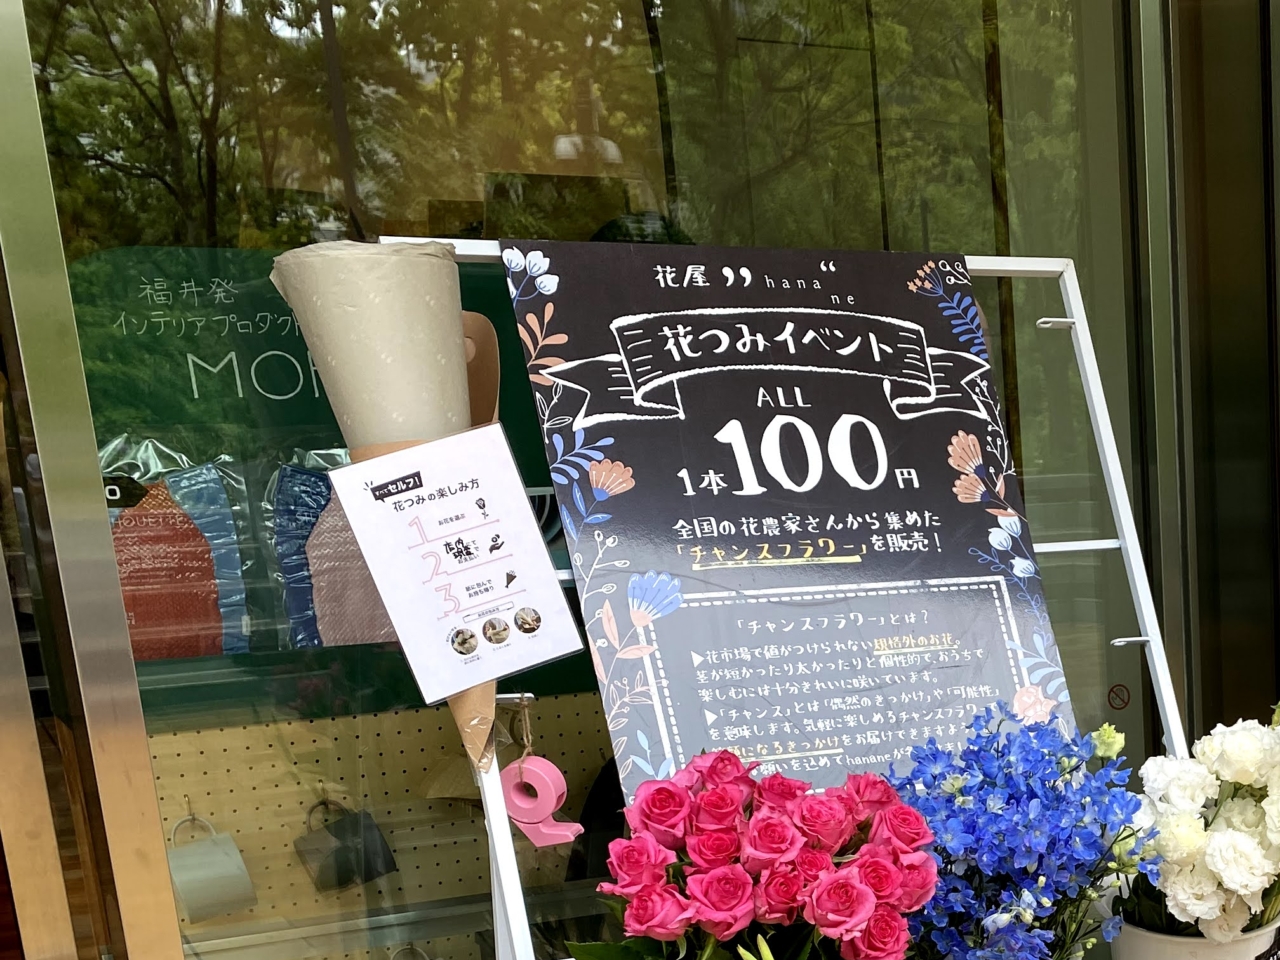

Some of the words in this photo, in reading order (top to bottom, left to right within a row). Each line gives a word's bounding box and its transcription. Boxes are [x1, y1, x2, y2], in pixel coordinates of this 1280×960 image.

[138, 276, 239, 307] 福井発
[652, 264, 711, 288] 花屋
[764, 275, 822, 289] hana
[830, 294, 855, 304] ne
[657, 320, 894, 363] 花つみイベント
[757, 386, 812, 408] ALL
[392, 478, 480, 512] 花つみの楽しみ方
[671, 510, 943, 540] 全国の花農家さんから集めた
